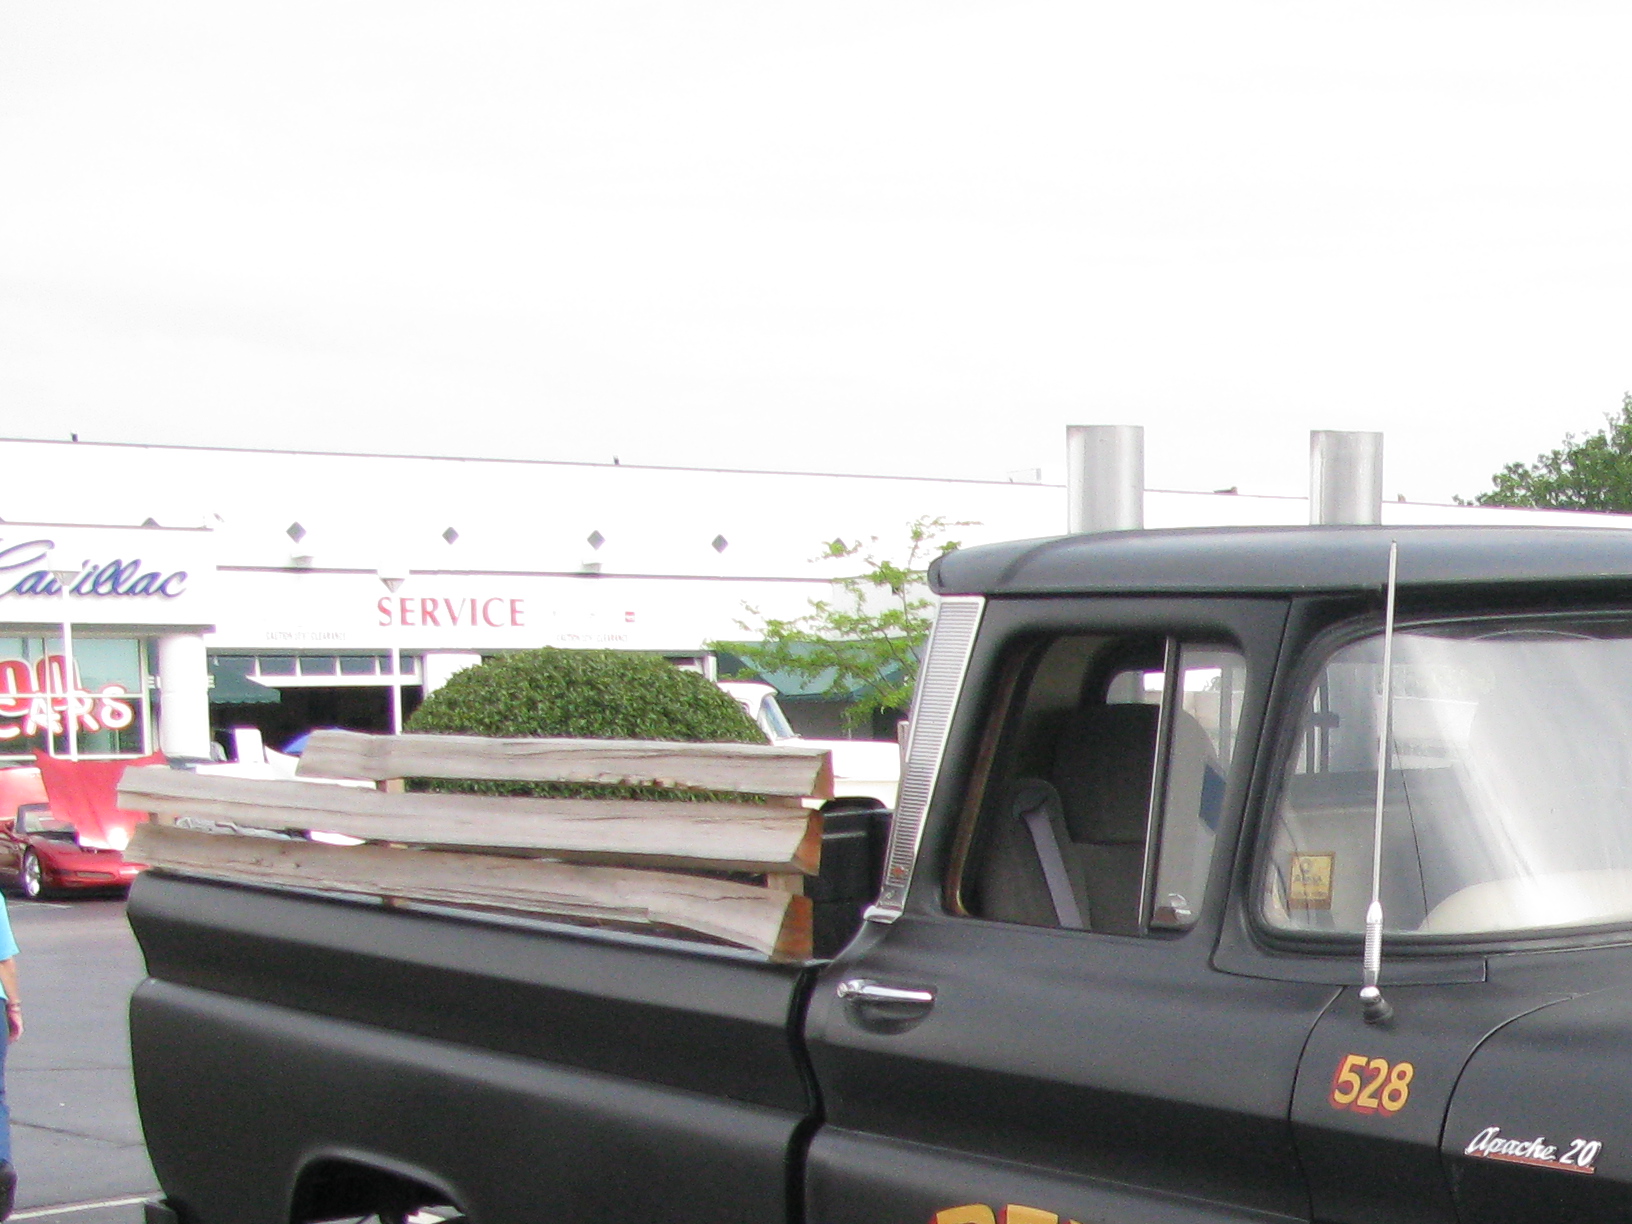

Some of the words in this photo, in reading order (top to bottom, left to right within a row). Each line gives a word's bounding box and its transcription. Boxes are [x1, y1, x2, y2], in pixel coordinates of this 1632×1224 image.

[377, 596, 525, 627] SERVICE
[1331, 1053, 1415, 1114] 528
[1464, 1126, 1557, 1162] Apache
[1558, 1138, 1602, 1168] 20
